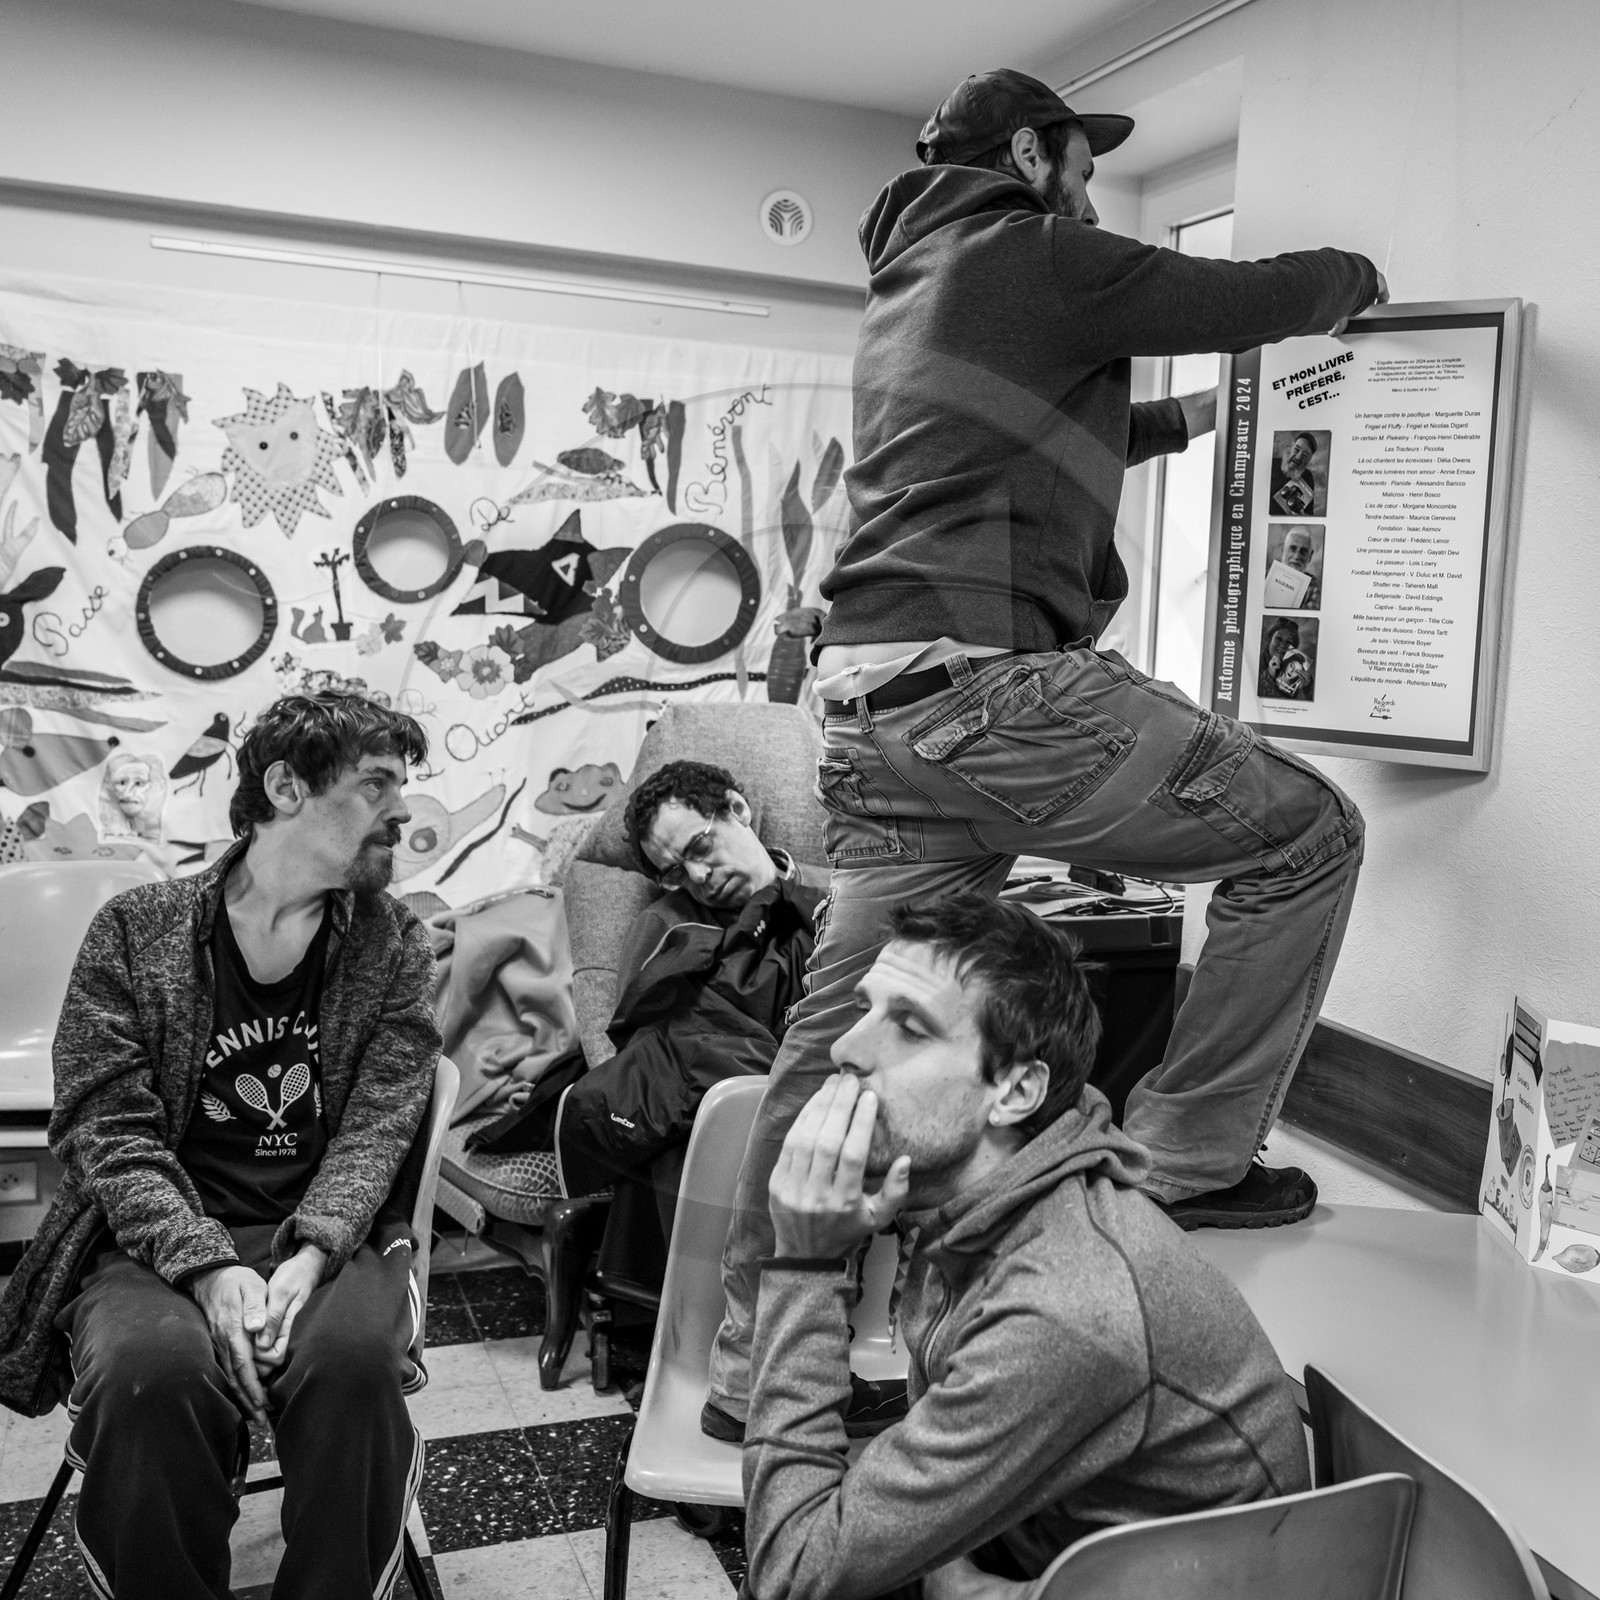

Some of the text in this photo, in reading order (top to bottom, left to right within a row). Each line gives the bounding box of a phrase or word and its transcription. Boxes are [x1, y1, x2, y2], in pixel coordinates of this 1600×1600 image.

[1272, 351, 1355, 391] ET MON LIVRE
[1286, 369, 1346, 400] PRÉFÉRÉ,
[1298, 390, 1340, 410] C'EST...
[1217, 378, 1252, 701] Automne photographique en Champsaur 2024
[1431, 681, 1447, 689] Mistry
[206, 1016, 289, 1069] ENNIS
[255, 1148, 297, 1157] Since 1978
[257, 1133, 298, 1147] NYC
